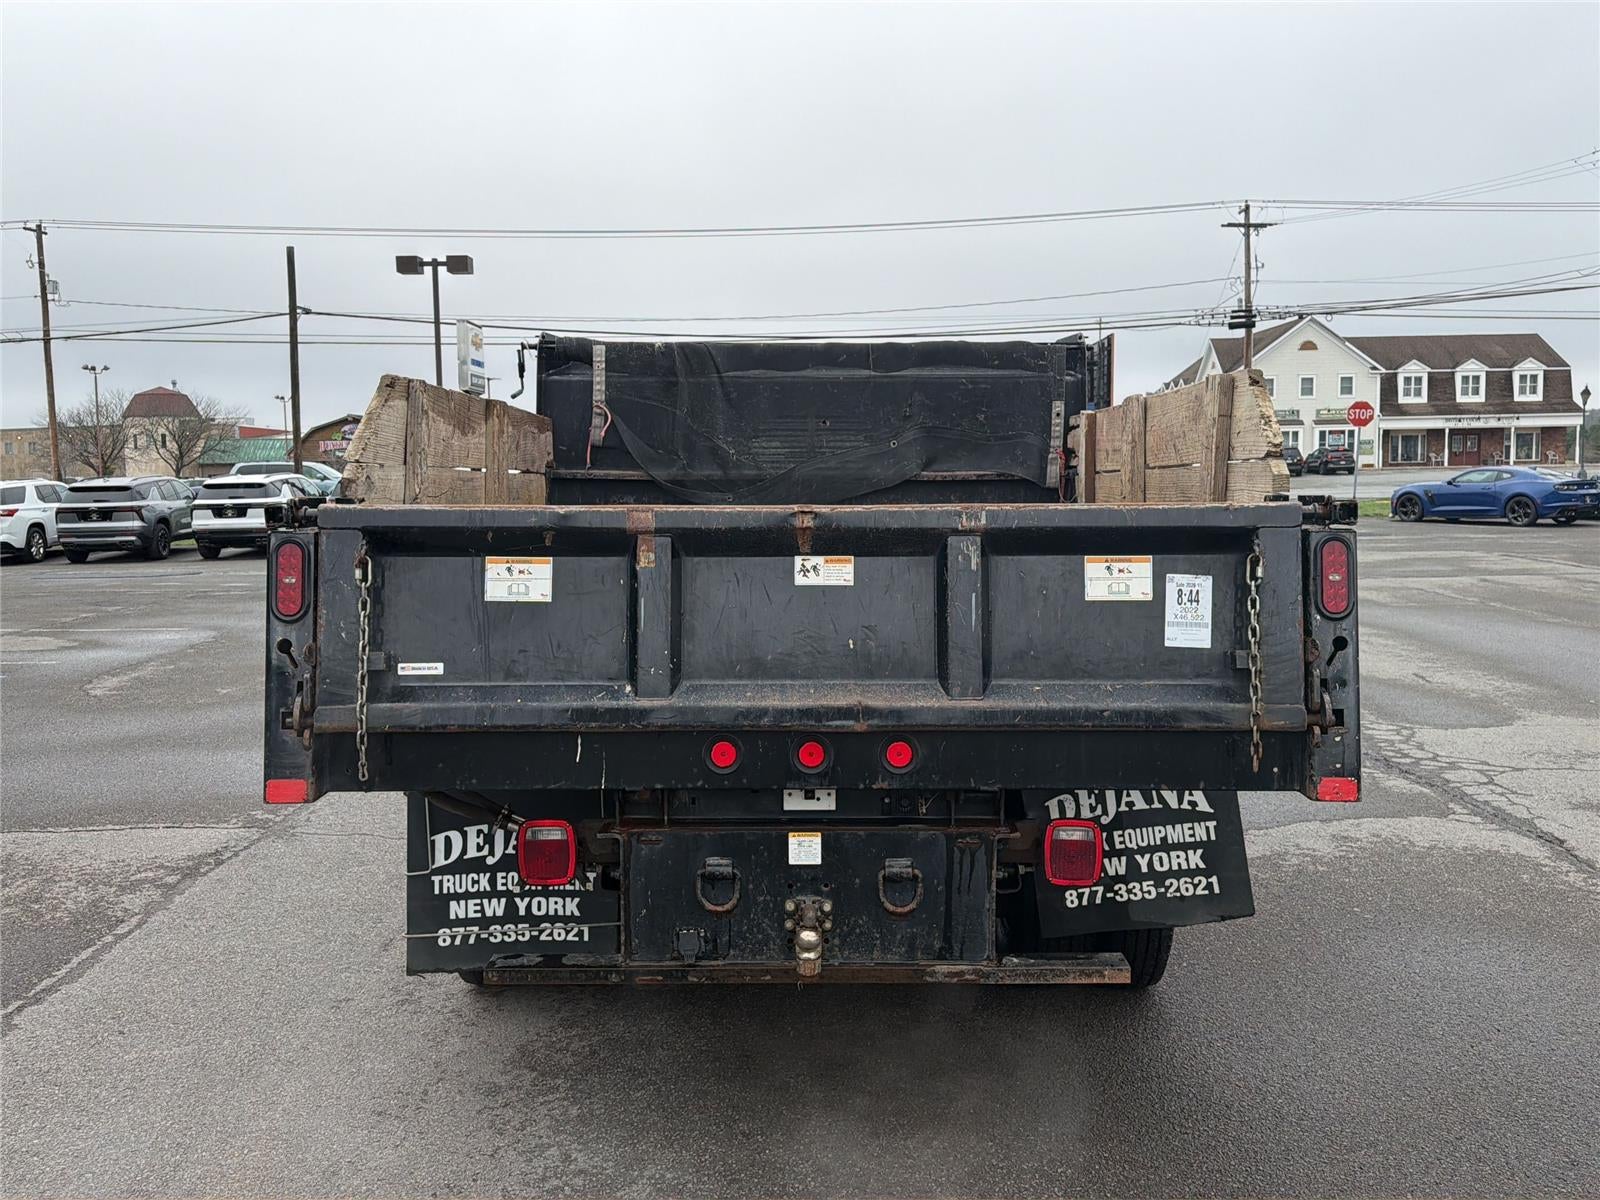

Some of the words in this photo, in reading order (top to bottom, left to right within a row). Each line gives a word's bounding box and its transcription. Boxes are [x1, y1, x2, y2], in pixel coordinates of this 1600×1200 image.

[1348, 408, 1374, 420] STOP
[1177, 588, 1200, 606] 8:44
[1179, 606, 1199, 614] 2022
[1045, 789, 1214, 824] DEJANA
[1114, 821, 1217, 850] EQUIPMENT
[1134, 849, 1206, 873] YORK
[431, 872, 492, 895] TRUCK
[1064, 875, 1220, 909] 877-335-2621
[449, 897, 506, 920] NEW
[514, 897, 581, 917] YORK
[437, 923, 589, 947] 877-335-2621
